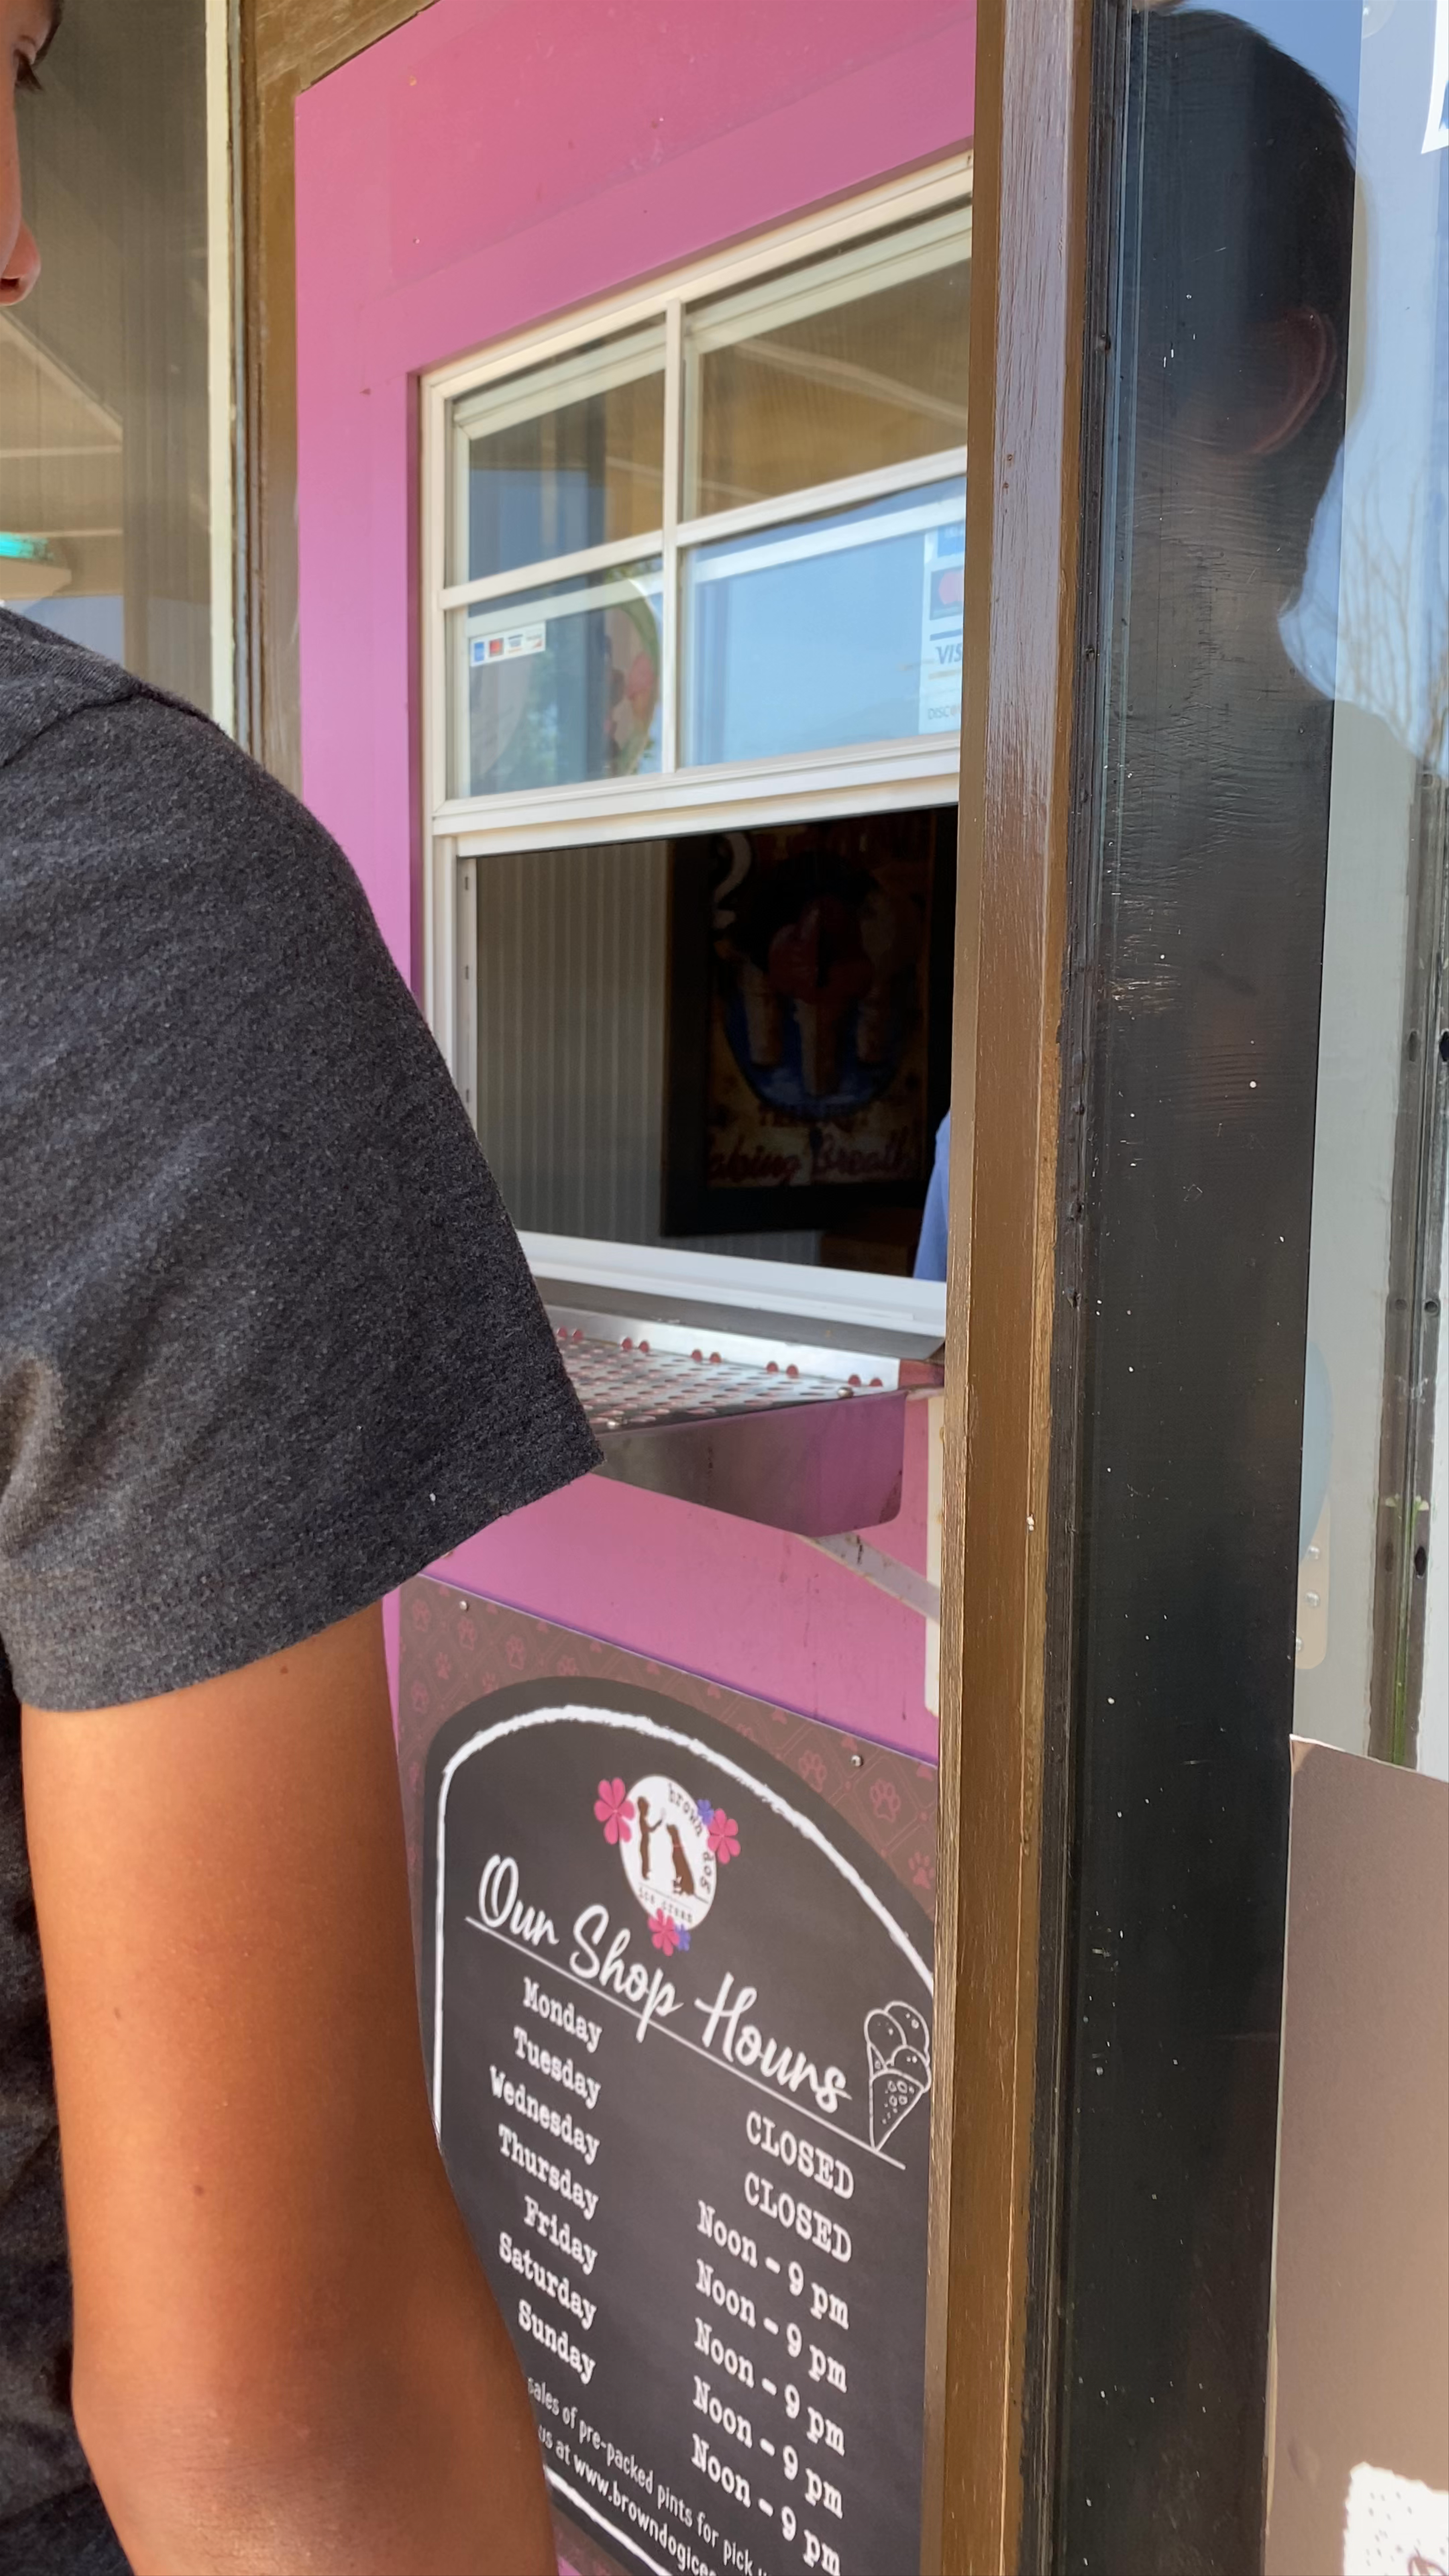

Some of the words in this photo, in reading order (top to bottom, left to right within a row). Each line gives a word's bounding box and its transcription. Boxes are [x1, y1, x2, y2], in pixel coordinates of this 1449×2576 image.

[669, 1782, 703, 1838] brown
[700, 1851, 714, 1894] dog
[478, 1854, 559, 1945] Our
[569, 1904, 684, 2042] Shop
[695, 1972, 852, 2113] Hours
[523, 1977, 602, 2053] Monday
[489, 2065, 600, 2165] Wednesday
[514, 2026, 601, 2109] Tuesday
[498, 2124, 598, 2220] Thursday
[746, 2111, 854, 2199] CLOSED
[524, 2195, 598, 2275] Friday
[697, 2200, 757, 2268] Noon
[765, 2257, 780, 2274] -
[788, 2261, 804, 2296] 9
[810, 2282, 849, 2330] pm
[744, 2172, 851, 2262] CLOSED
[499, 2232, 597, 2330] Saturday
[695, 2259, 756, 2328] Noon
[763, 2318, 778, 2335] -
[786, 2323, 802, 2358] 9
[808, 2345, 847, 2393] pm
[518, 2299, 596, 2384] Sunday
[694, 2317, 754, 2388] Noon
[762, 2378, 777, 2396] -
[784, 2384, 800, 2419] 9
[806, 2407, 845, 2456] pm
[528, 2377, 559, 2415] sales
[562, 2406, 578, 2428] of
[579, 2419, 654, 2494] pre-packed
[658, 2485, 692, 2527] pints
[697, 2511, 719, 2548] for
[723, 2540, 753, 2576] pick
[538, 2425, 553, 2449] us
[556, 2440, 570, 2465] at
[574, 2455, 717, 2576] www.browndogice
[693, 2376, 752, 2448] Noon
[760, 2438, 775, 2456] -
[783, 2445, 798, 2480] 9
[804, 2468, 843, 2519] pm
[691, 2433, 751, 2508] Noon
[758, 2498, 773, 2517] -
[781, 2506, 796, 2541] 9
[803, 2529, 841, 2576] pm
